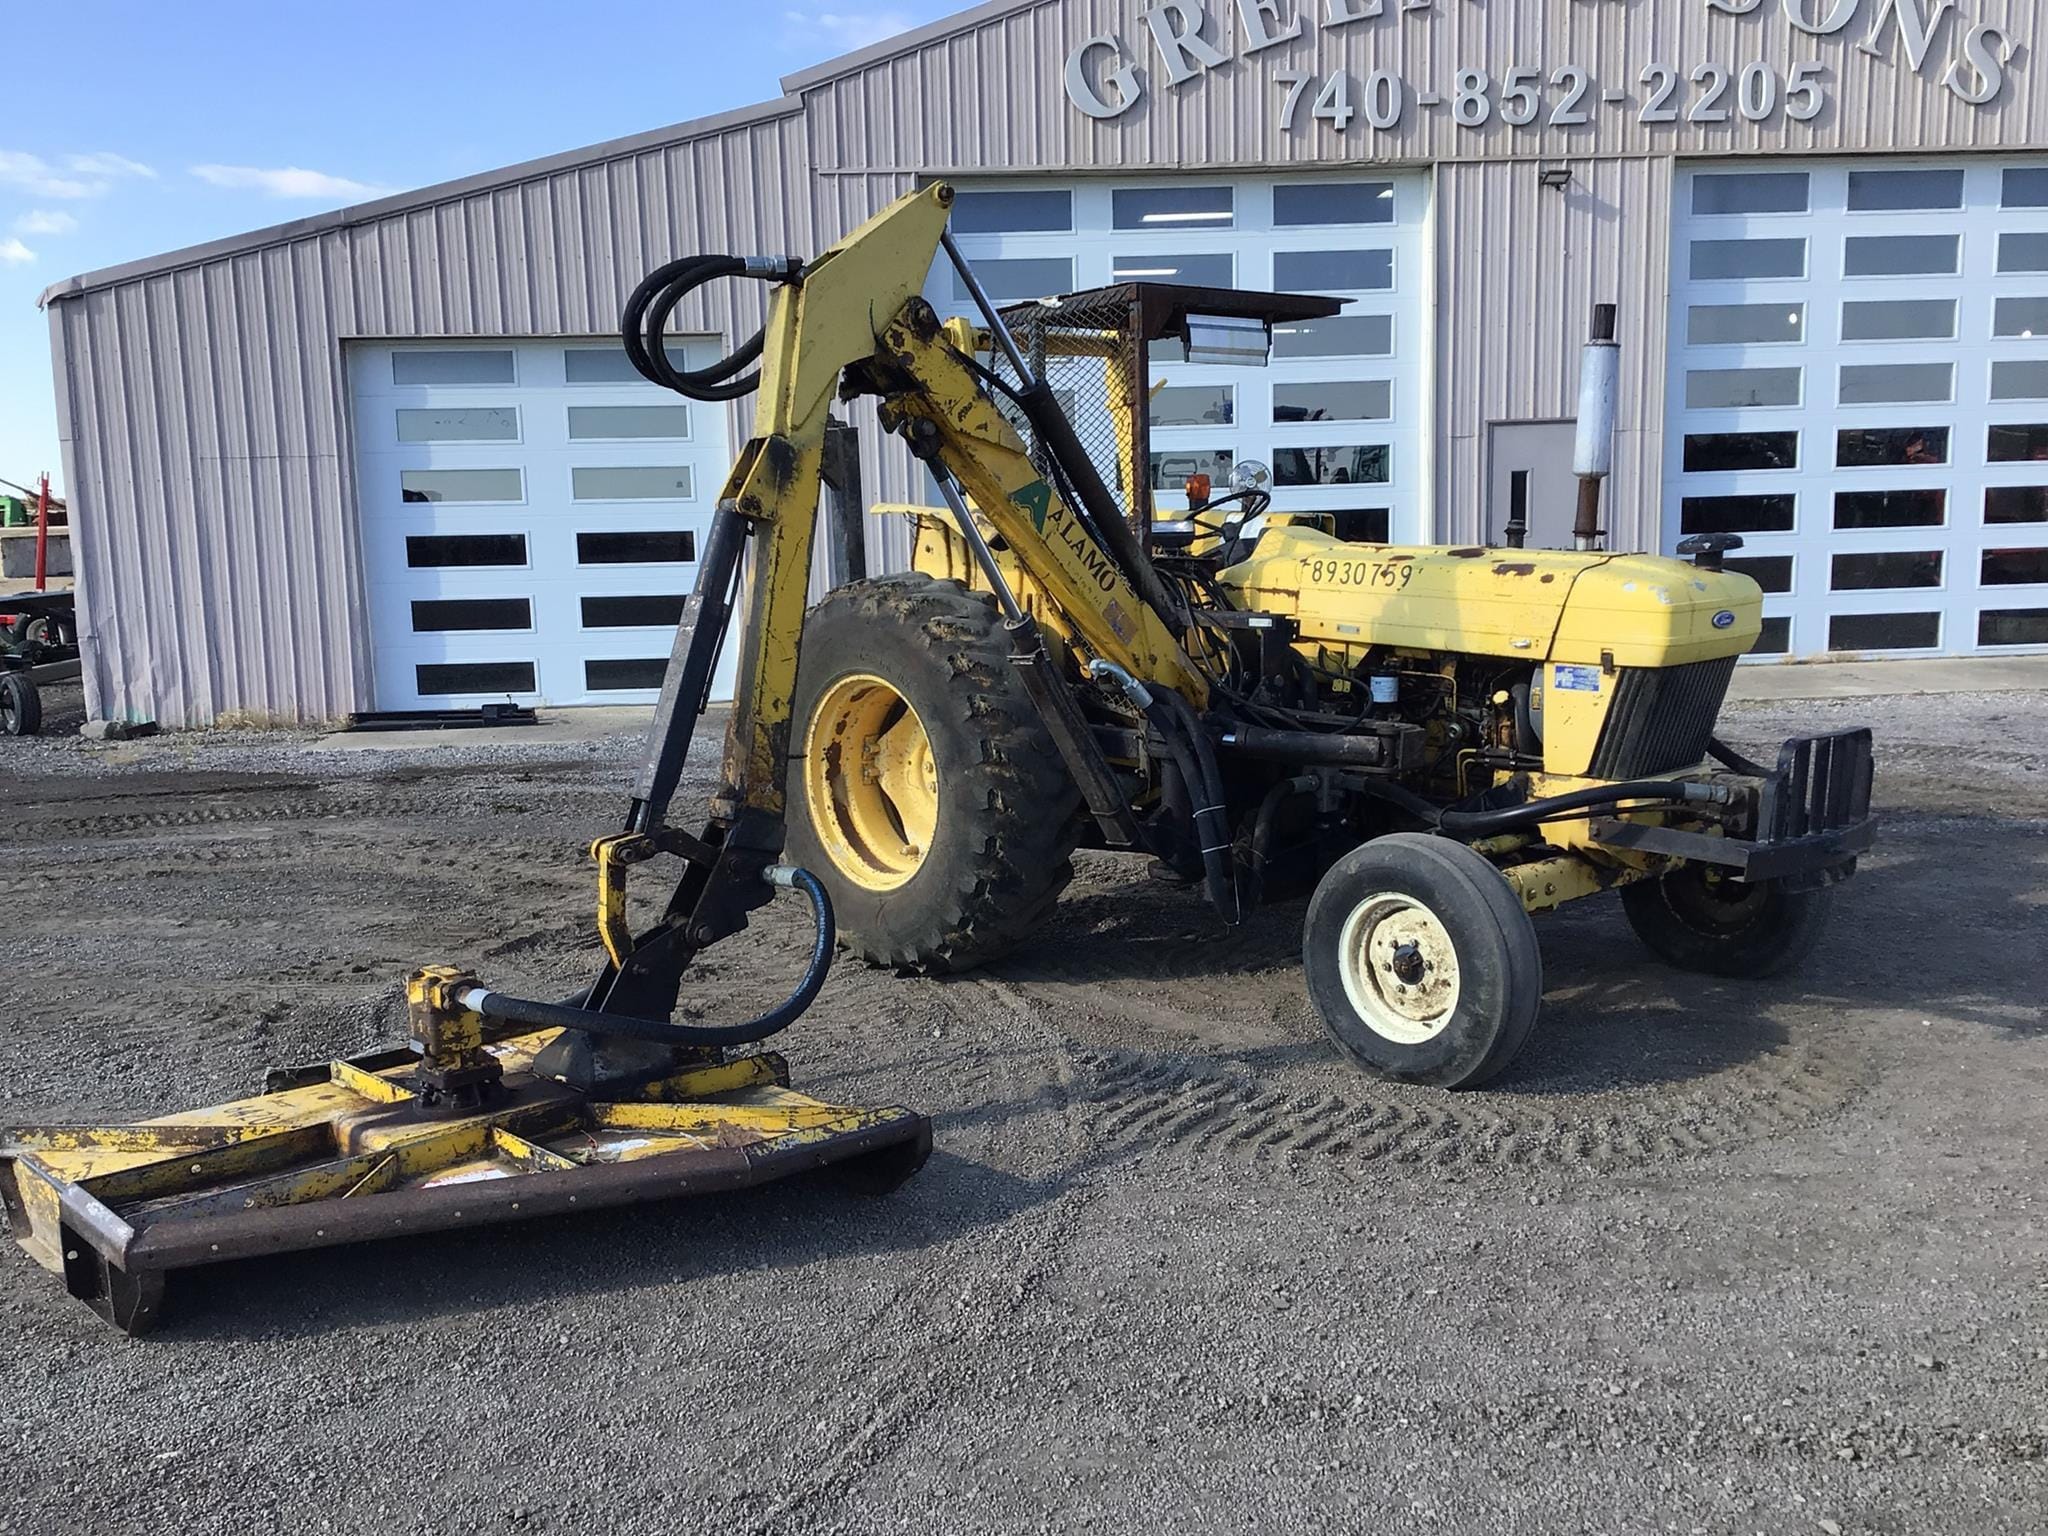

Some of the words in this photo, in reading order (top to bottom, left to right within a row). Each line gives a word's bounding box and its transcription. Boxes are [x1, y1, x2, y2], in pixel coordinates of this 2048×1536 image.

[1064, 0, 1431, 119] GRE
[1273, 61, 1823, 129] 740-852-2205
[1047, 508, 1116, 592] ALAMO
[1312, 560, 1412, 588] 8930759
